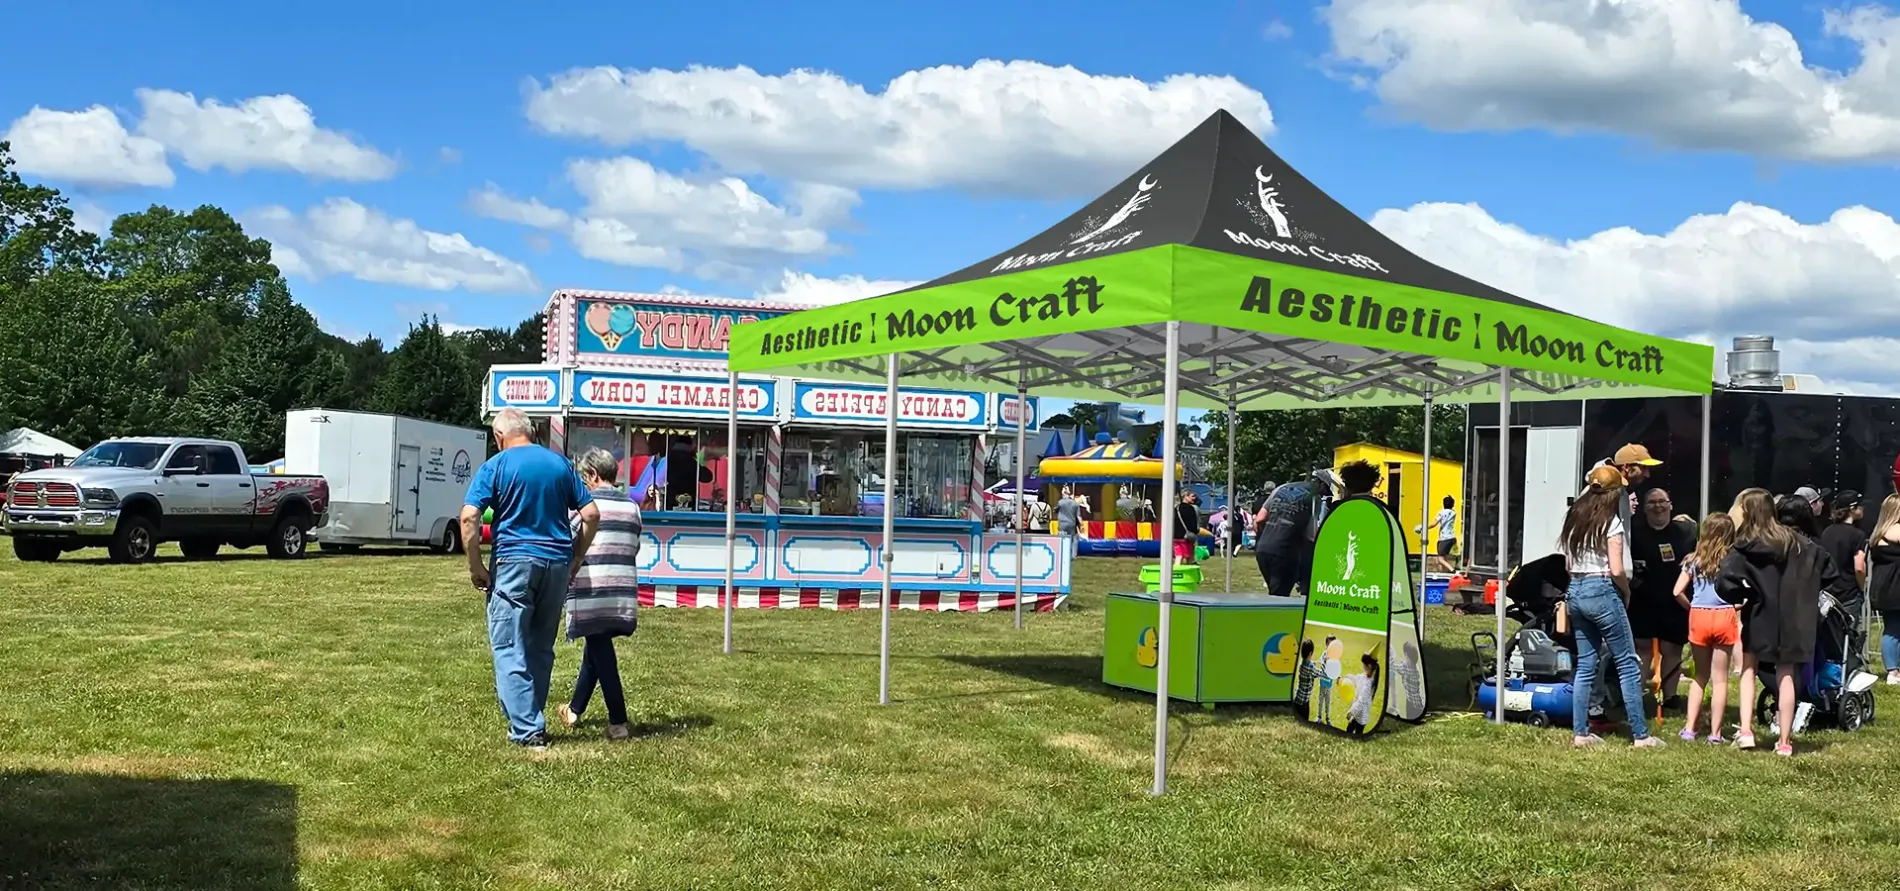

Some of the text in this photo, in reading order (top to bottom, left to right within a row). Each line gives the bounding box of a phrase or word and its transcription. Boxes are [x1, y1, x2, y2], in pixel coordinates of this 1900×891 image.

[990, 229, 1143, 274] Moon Craft
[1223, 228, 1390, 274] Moon Craft
[760, 274, 1105, 356] Aesthetic Moon Craft
[1239, 275, 1665, 375] Aesthetic Moon Craft
[1316, 580, 1346, 596] Moon
[1349, 584, 1381, 600] Craft
[1343, 602, 1361, 612] Moon
[1361, 605, 1379, 615] Craft
